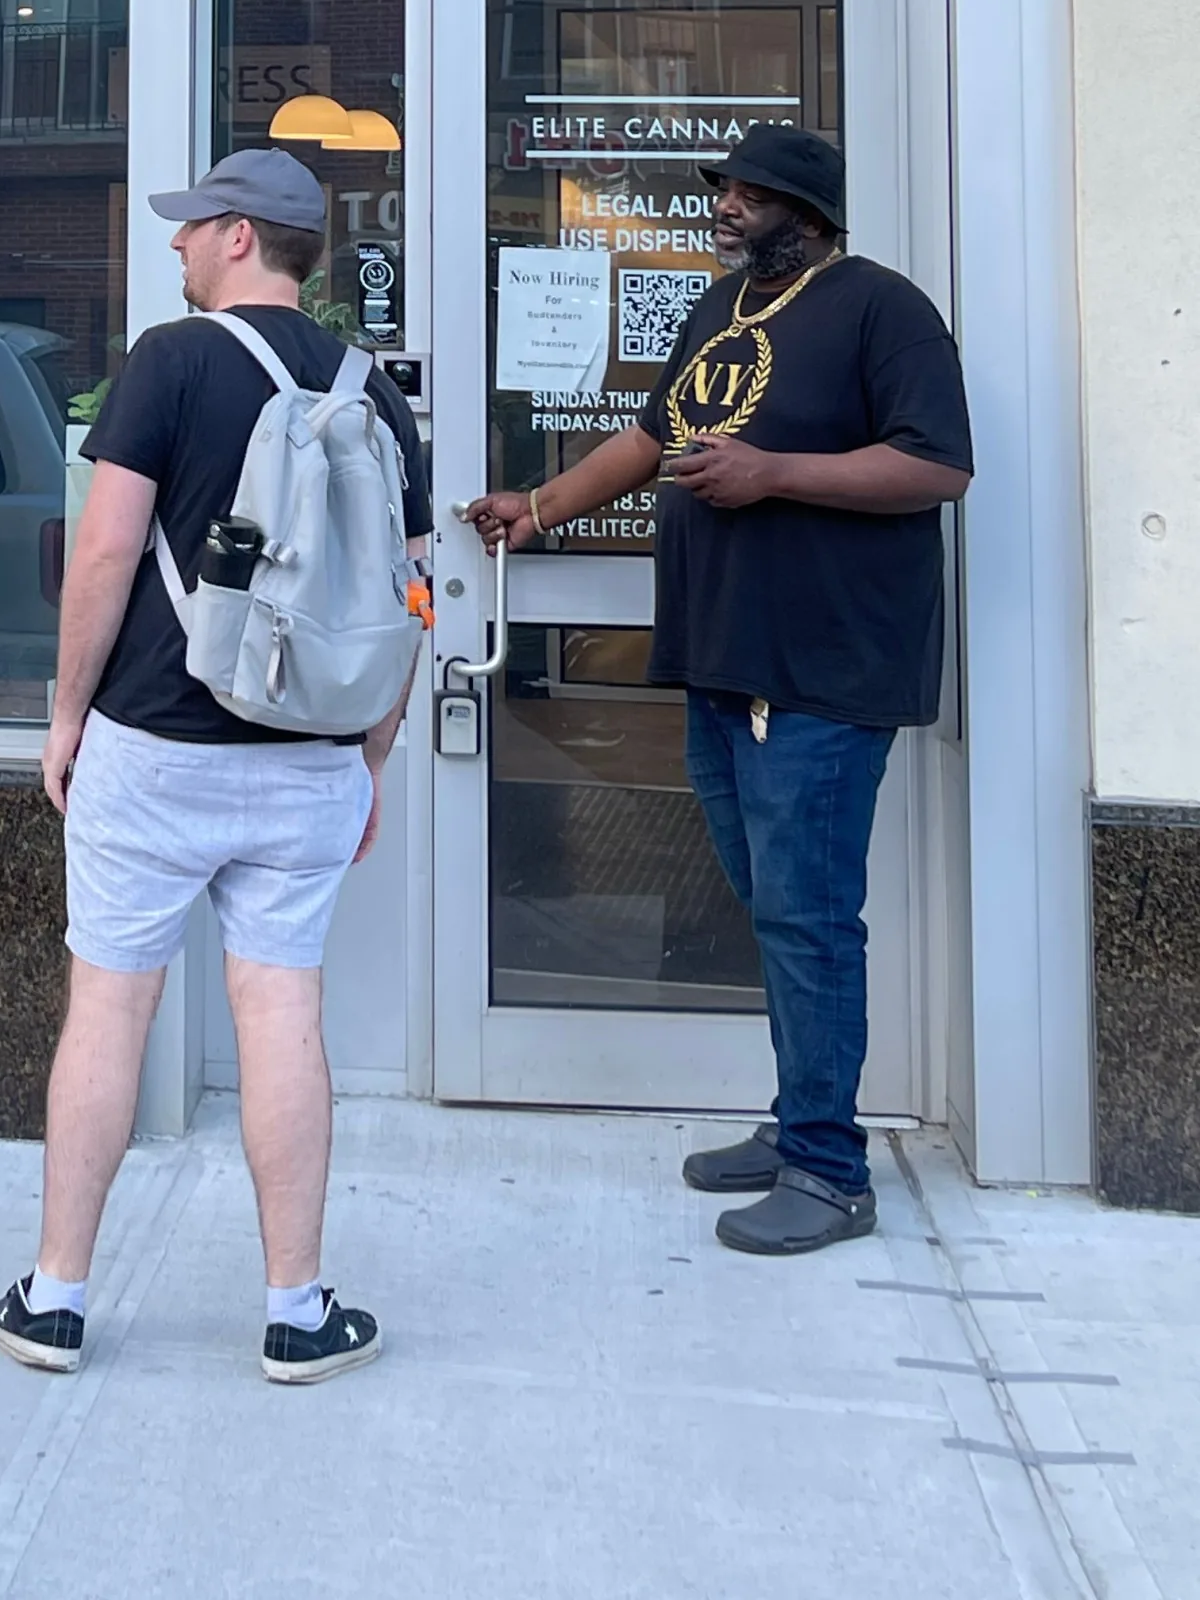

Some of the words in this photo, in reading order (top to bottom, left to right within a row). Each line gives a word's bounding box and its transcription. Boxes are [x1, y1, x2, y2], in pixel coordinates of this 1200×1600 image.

[531, 116, 606, 140] ELITE
[623, 117, 794, 140] CANNA
[581, 193, 663, 219] LEGAL
[666, 193, 718, 219] ADU
[559, 228, 609, 251] USE
[615, 228, 714, 253] DISPENS
[508, 269, 543, 285] Now
[549, 270, 601, 291] Hiring
[545, 295, 563, 305] For
[678, 360, 756, 406] NY
[601, 491, 657, 512] 18.5
